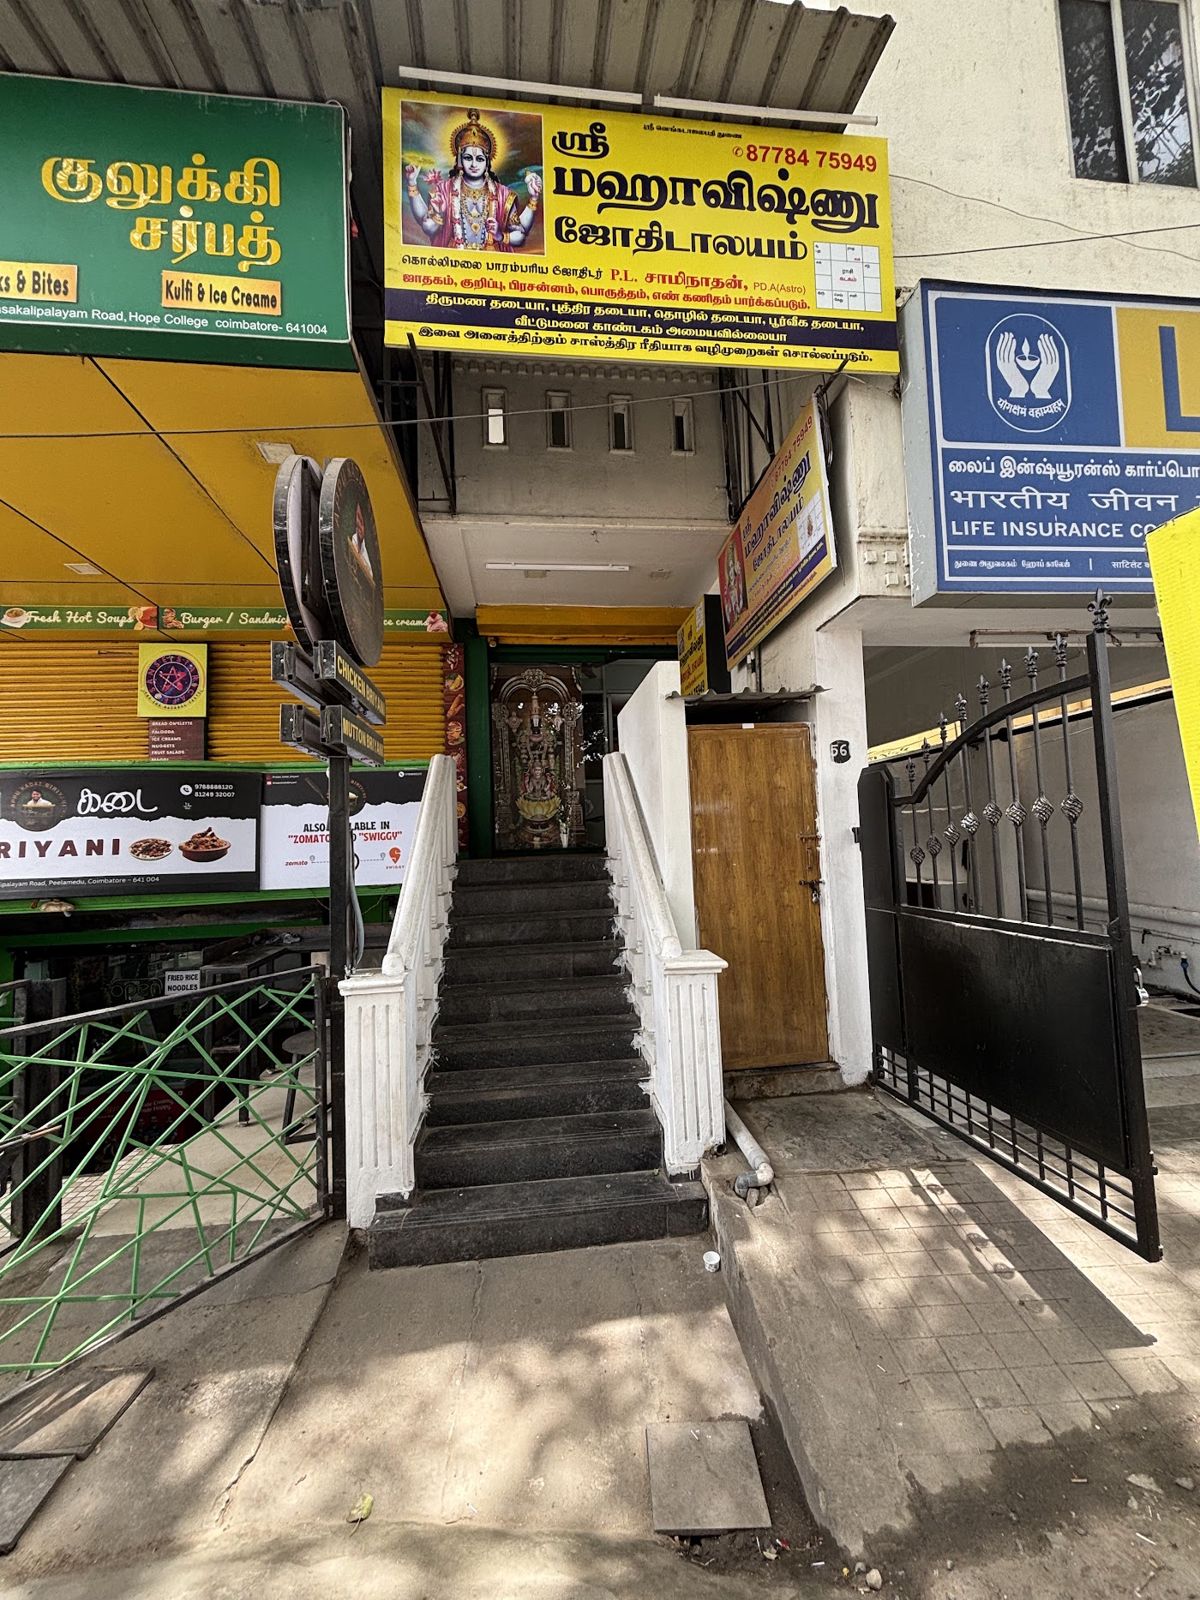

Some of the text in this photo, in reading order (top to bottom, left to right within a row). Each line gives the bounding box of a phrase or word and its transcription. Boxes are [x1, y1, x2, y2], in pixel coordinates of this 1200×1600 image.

[746, 144, 877, 173] 87784 75949
[41, 153, 282, 210] குலுக்கி
[553, 166, 879, 234] மஹாவிஷ்ணு
[129, 205, 281, 272] சர்பத்
[554, 215, 808, 260] ஜோதிடாலயம்
[32, 271, 69, 296] Bites
[402, 255, 806, 295] கொல்லிமலை பாரம்பரிய ஜோதிடர் P.L. சாமிநாதன், PD.A(Astro)
[165, 279, 277, 309] Kulfi & Ice Creame
[402, 273, 811, 311] ஜாதகம், குறிப்பு, பிரசன்னம், பொருத்தம், எண் கணிதம் பார்க்கப்படும்.
[91, 309, 127, 322] Road,
[129, 311, 160, 325] Hope
[164, 314, 208, 328] College
[286, 323, 328, 334] 641004
[426, 293, 487, 307] திருமண
[490, 299, 550, 313] தடையா,
[552, 302, 591, 315] புத்திர
[594, 305, 651, 319] தடையா,
[654, 308, 708, 323] தொழில்
[711, 314, 766, 326] தடையா,
[811, 320, 864, 332] தடையா,
[515, 314, 589, 331] வீட்டுமனை
[418, 326, 460, 338] இவை
[464, 330, 567, 346] அனைத்திற்கும்
[640, 337, 692, 352] ரீதியாக
[695, 343, 779, 358] வழிமுறைகள்
[949, 456, 995, 474] லைப்
[1000, 455, 1121, 482] இன்ஷ்யூரன்ஸ்
[950, 485, 1071, 510] भारतीय
[1088, 487, 1179, 512] जीवन
[951, 520, 995, 536] LIFE
[1003, 522, 1124, 538] INSURANCE
[66, 611, 92, 624] Hot
[96, 611, 134, 627] Soups
[181, 613, 223, 629] Burger
[239, 611, 287, 624] Sandwic
[337, 655, 366, 698] CHICKEN
[343, 717, 366, 747] MUTTON
[77, 787, 158, 815] கடை
[303, 823, 325, 832] ALSO
[380, 821, 390, 830] IN
[0, 838, 120, 859] RIYANI
[88, 877, 126, 885] Coimbatore
[167, 973, 199, 982] FRIED RICE
[167, 983, 198, 992] NOODLES
